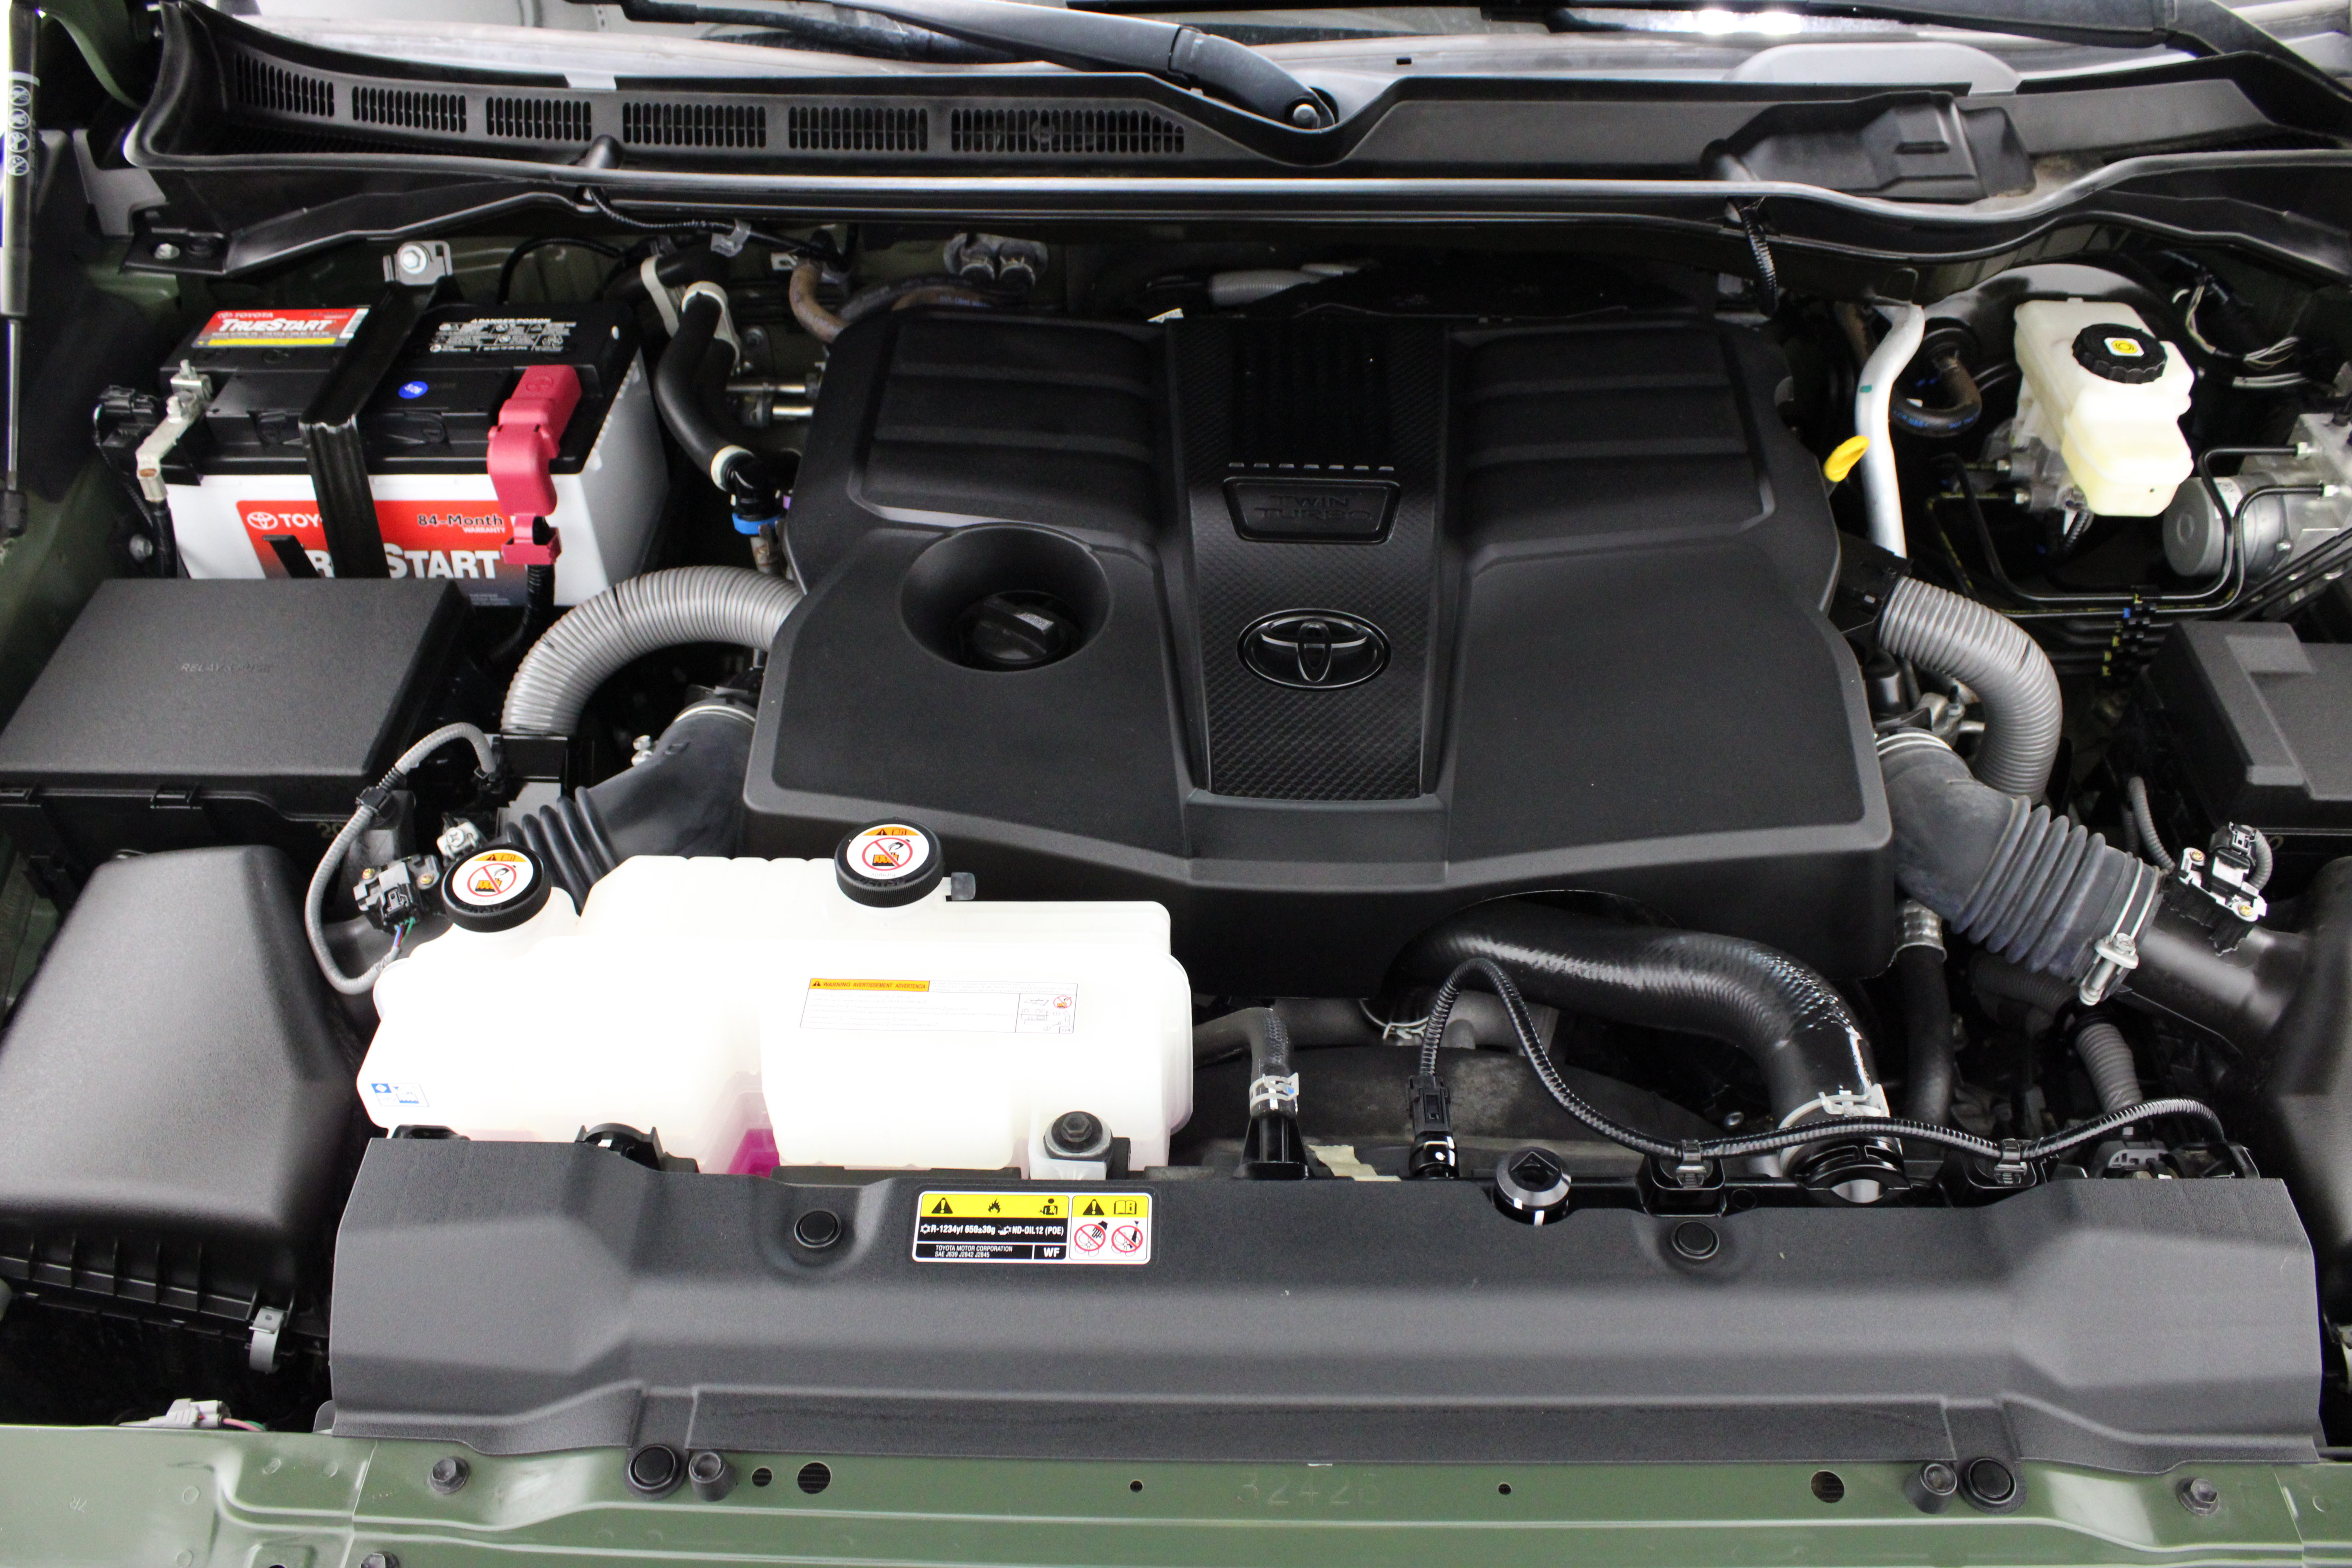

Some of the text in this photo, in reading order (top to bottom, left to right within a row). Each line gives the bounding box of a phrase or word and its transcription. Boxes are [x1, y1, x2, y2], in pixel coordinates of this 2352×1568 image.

[1270, 494, 1349, 507] TWIN
[417, 514, 503, 526] 84-Month
[1254, 507, 1371, 521] TURBO
[931, 1225, 963, 1235] R-1234yf
[965, 1225, 996, 1236] 650±30g
[1045, 1226, 1064, 1236] (POE)
[1043, 1247, 1060, 1258] WF
